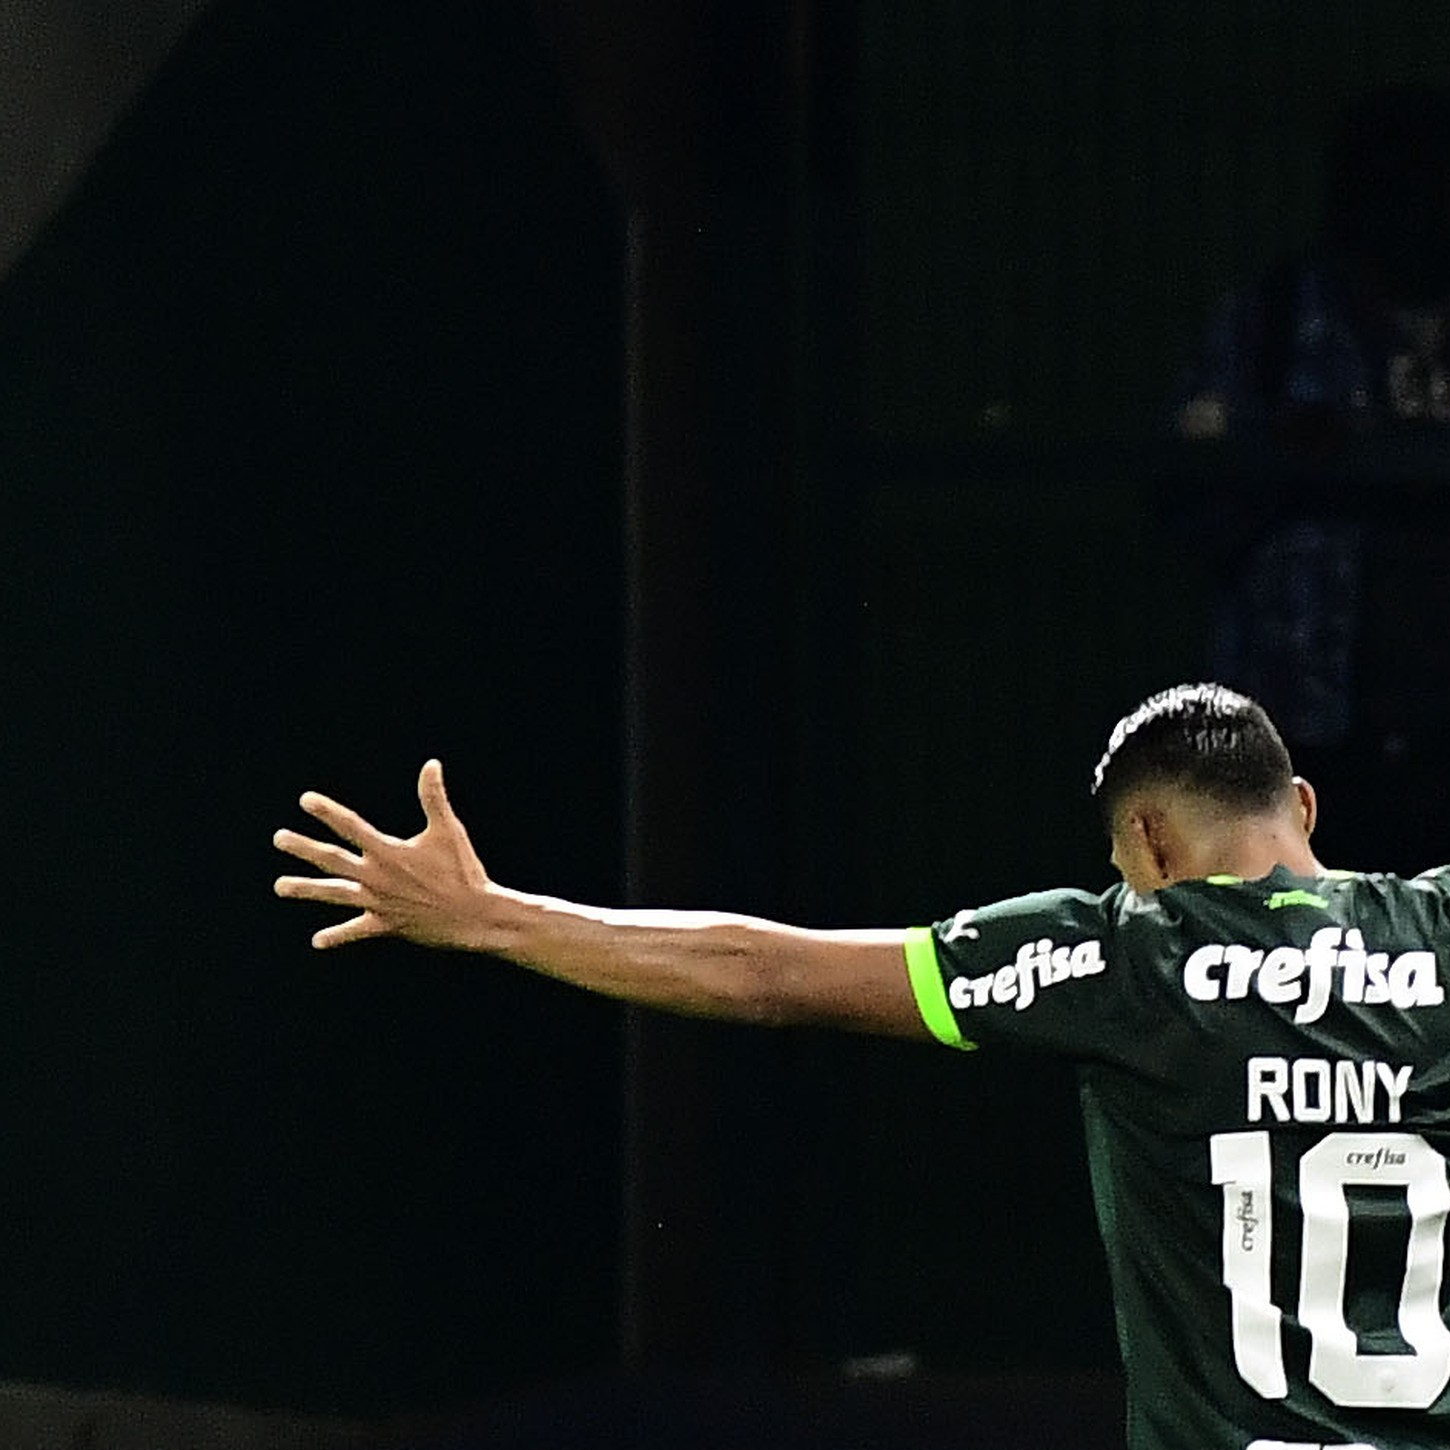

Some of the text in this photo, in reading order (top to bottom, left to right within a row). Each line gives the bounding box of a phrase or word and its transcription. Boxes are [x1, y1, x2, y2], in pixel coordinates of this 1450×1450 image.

[949, 938, 1106, 1011] crefisa
[1184, 926, 1445, 1025] crefisa
[1247, 1057, 1414, 1124] RONY
[1346, 1147, 1407, 1170] crefisa
